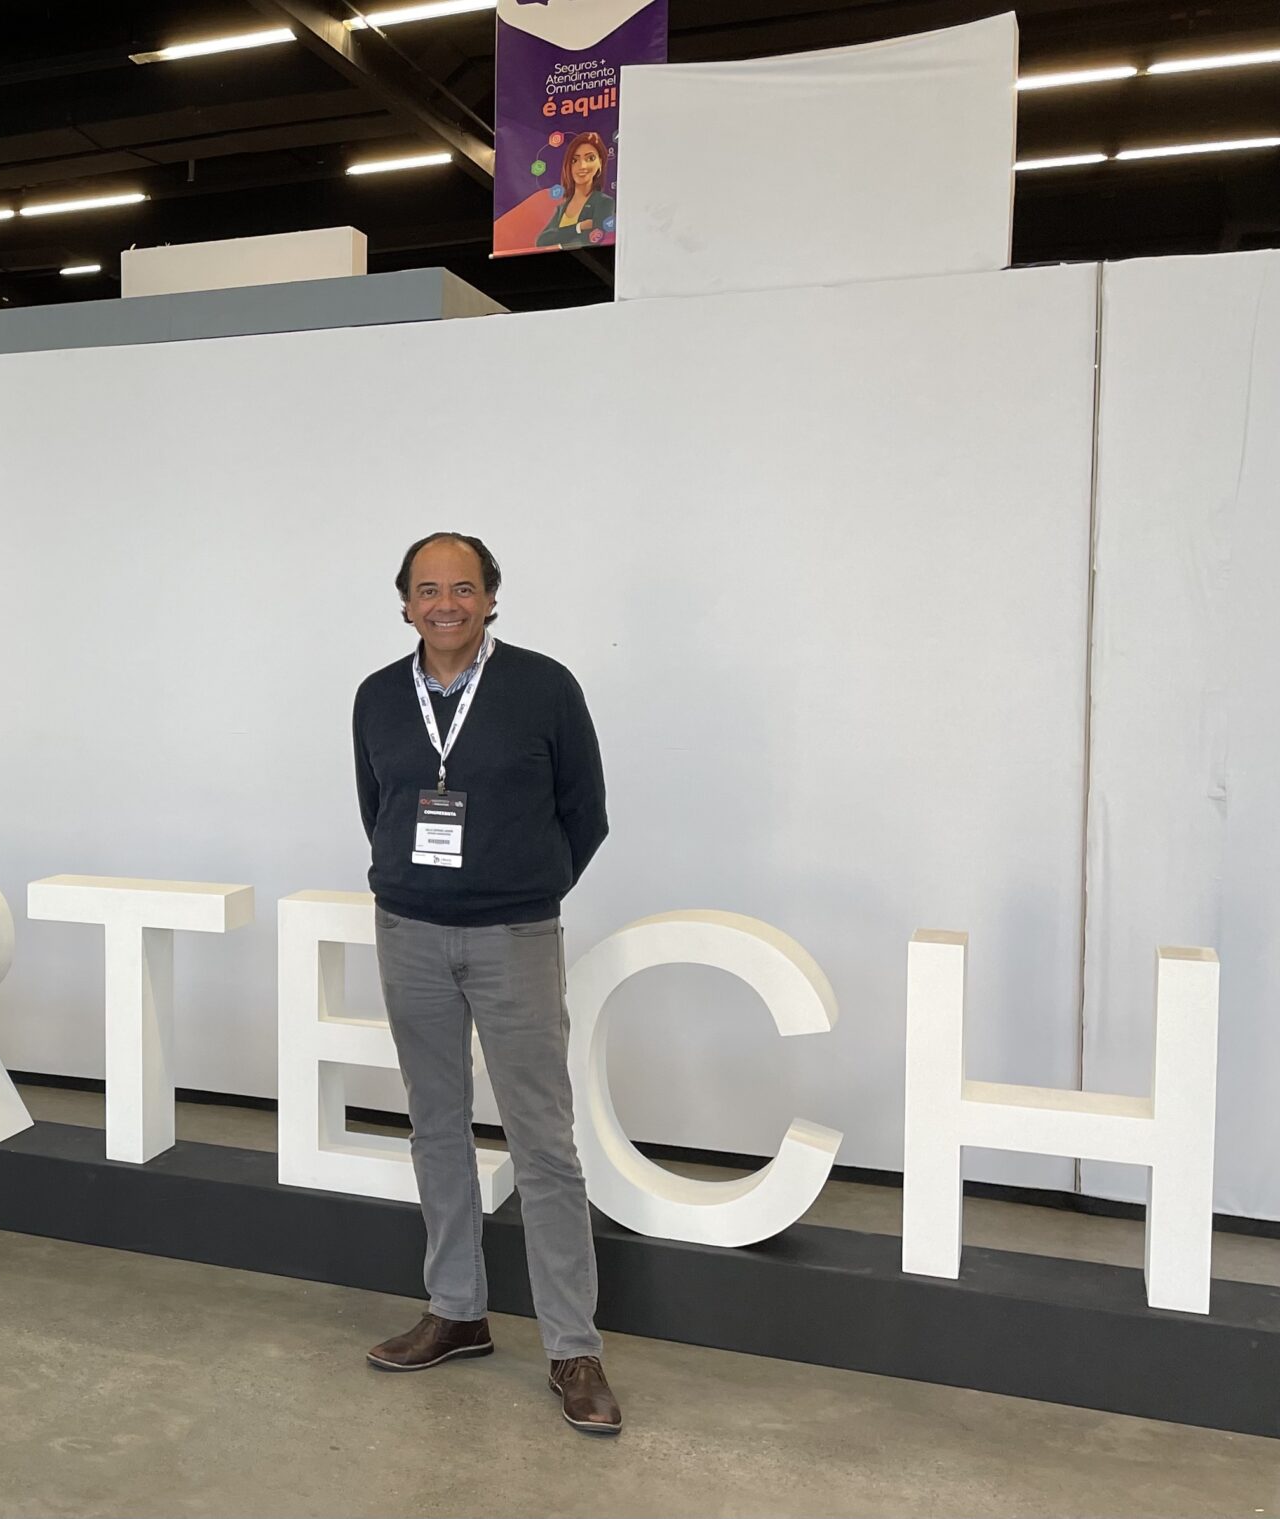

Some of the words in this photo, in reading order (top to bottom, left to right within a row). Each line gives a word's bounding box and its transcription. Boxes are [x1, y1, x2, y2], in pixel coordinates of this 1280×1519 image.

[545, 67, 615, 85] Atendimento
[554, 60, 598, 75] Seguros
[546, 75, 616, 95] Omnichannel
[542, 96, 557, 117] é
[560, 87, 617, 117] aqui!
